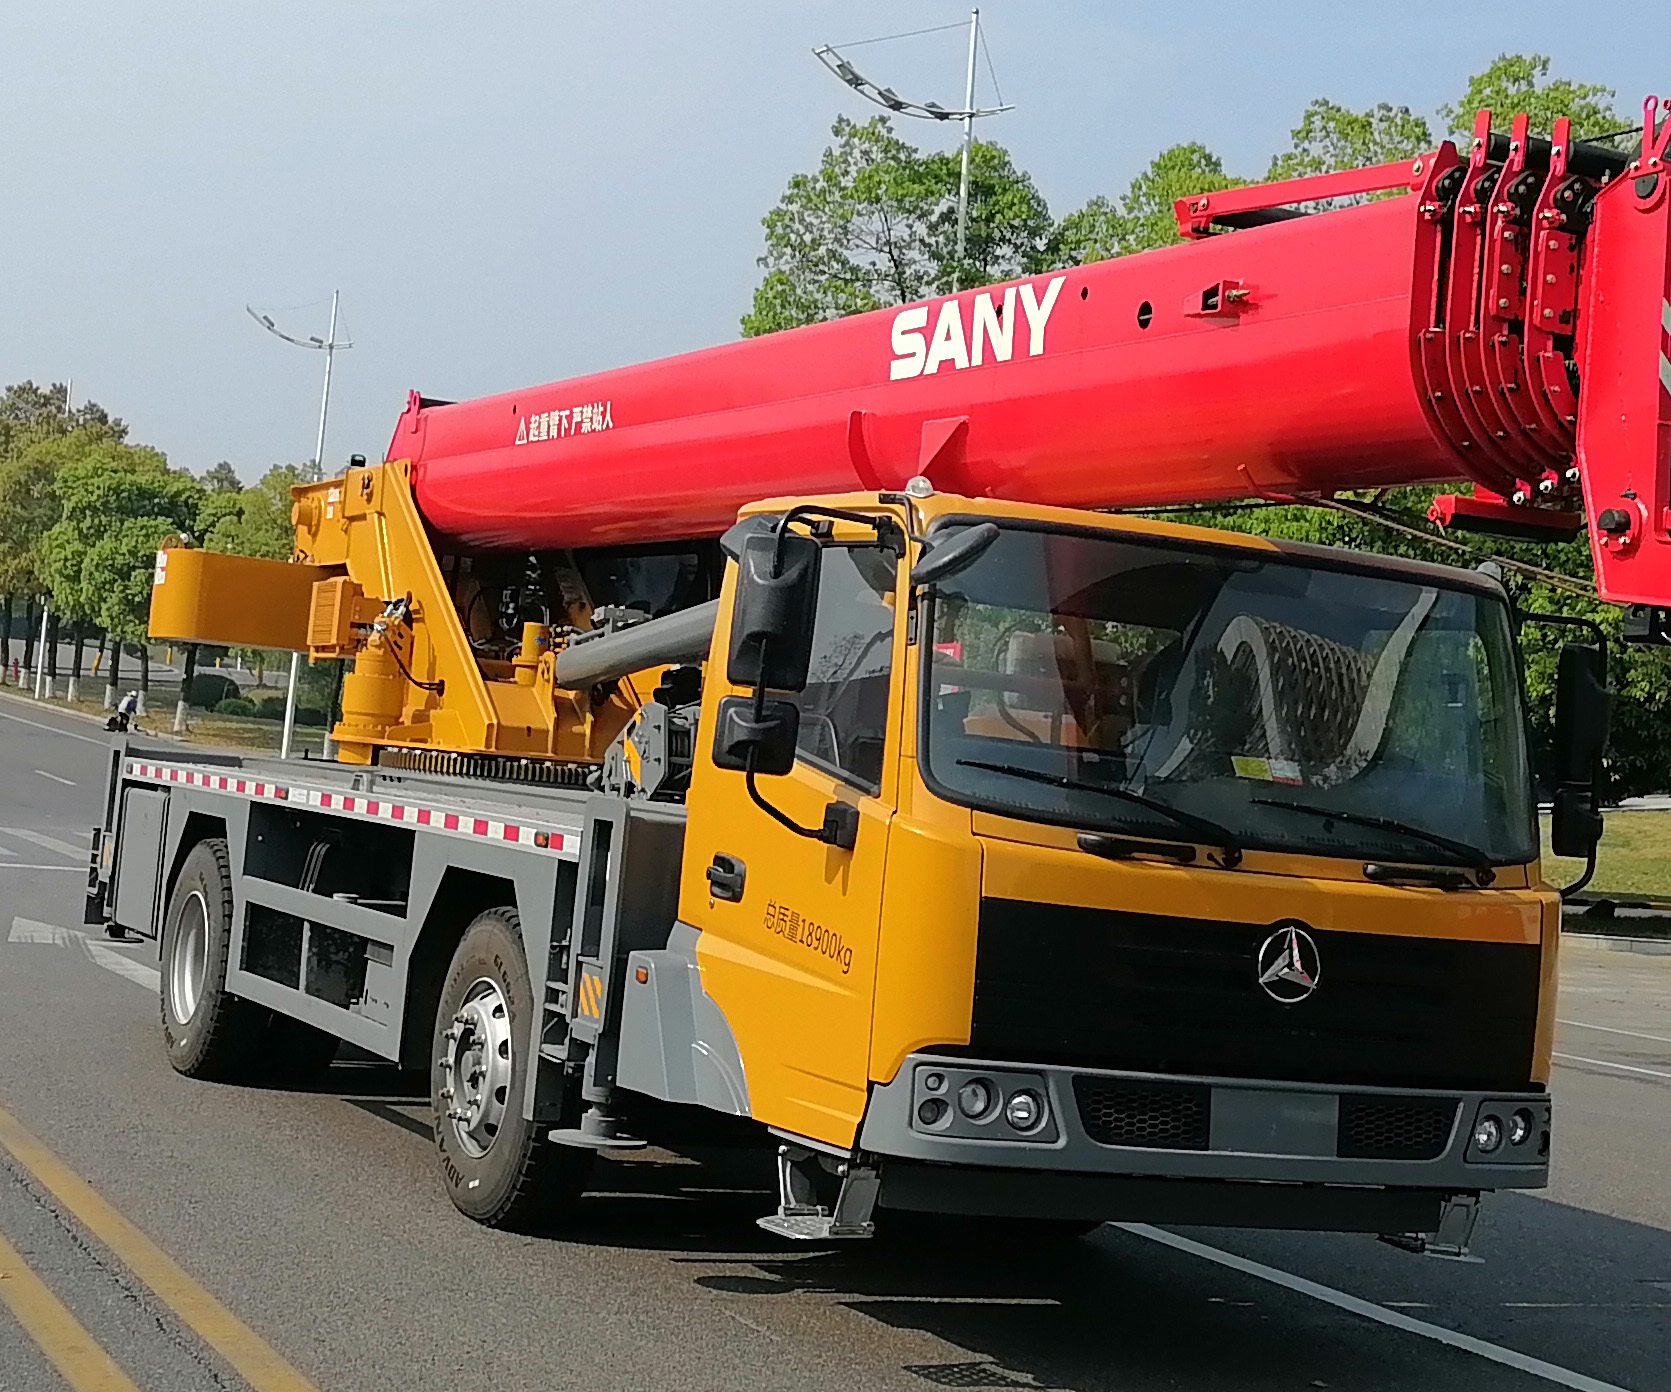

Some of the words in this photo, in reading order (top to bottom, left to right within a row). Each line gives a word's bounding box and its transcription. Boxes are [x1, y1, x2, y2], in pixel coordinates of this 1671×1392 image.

[889, 276, 1067, 381] SANY
[763, 898, 853, 975] 总质量18900kg
